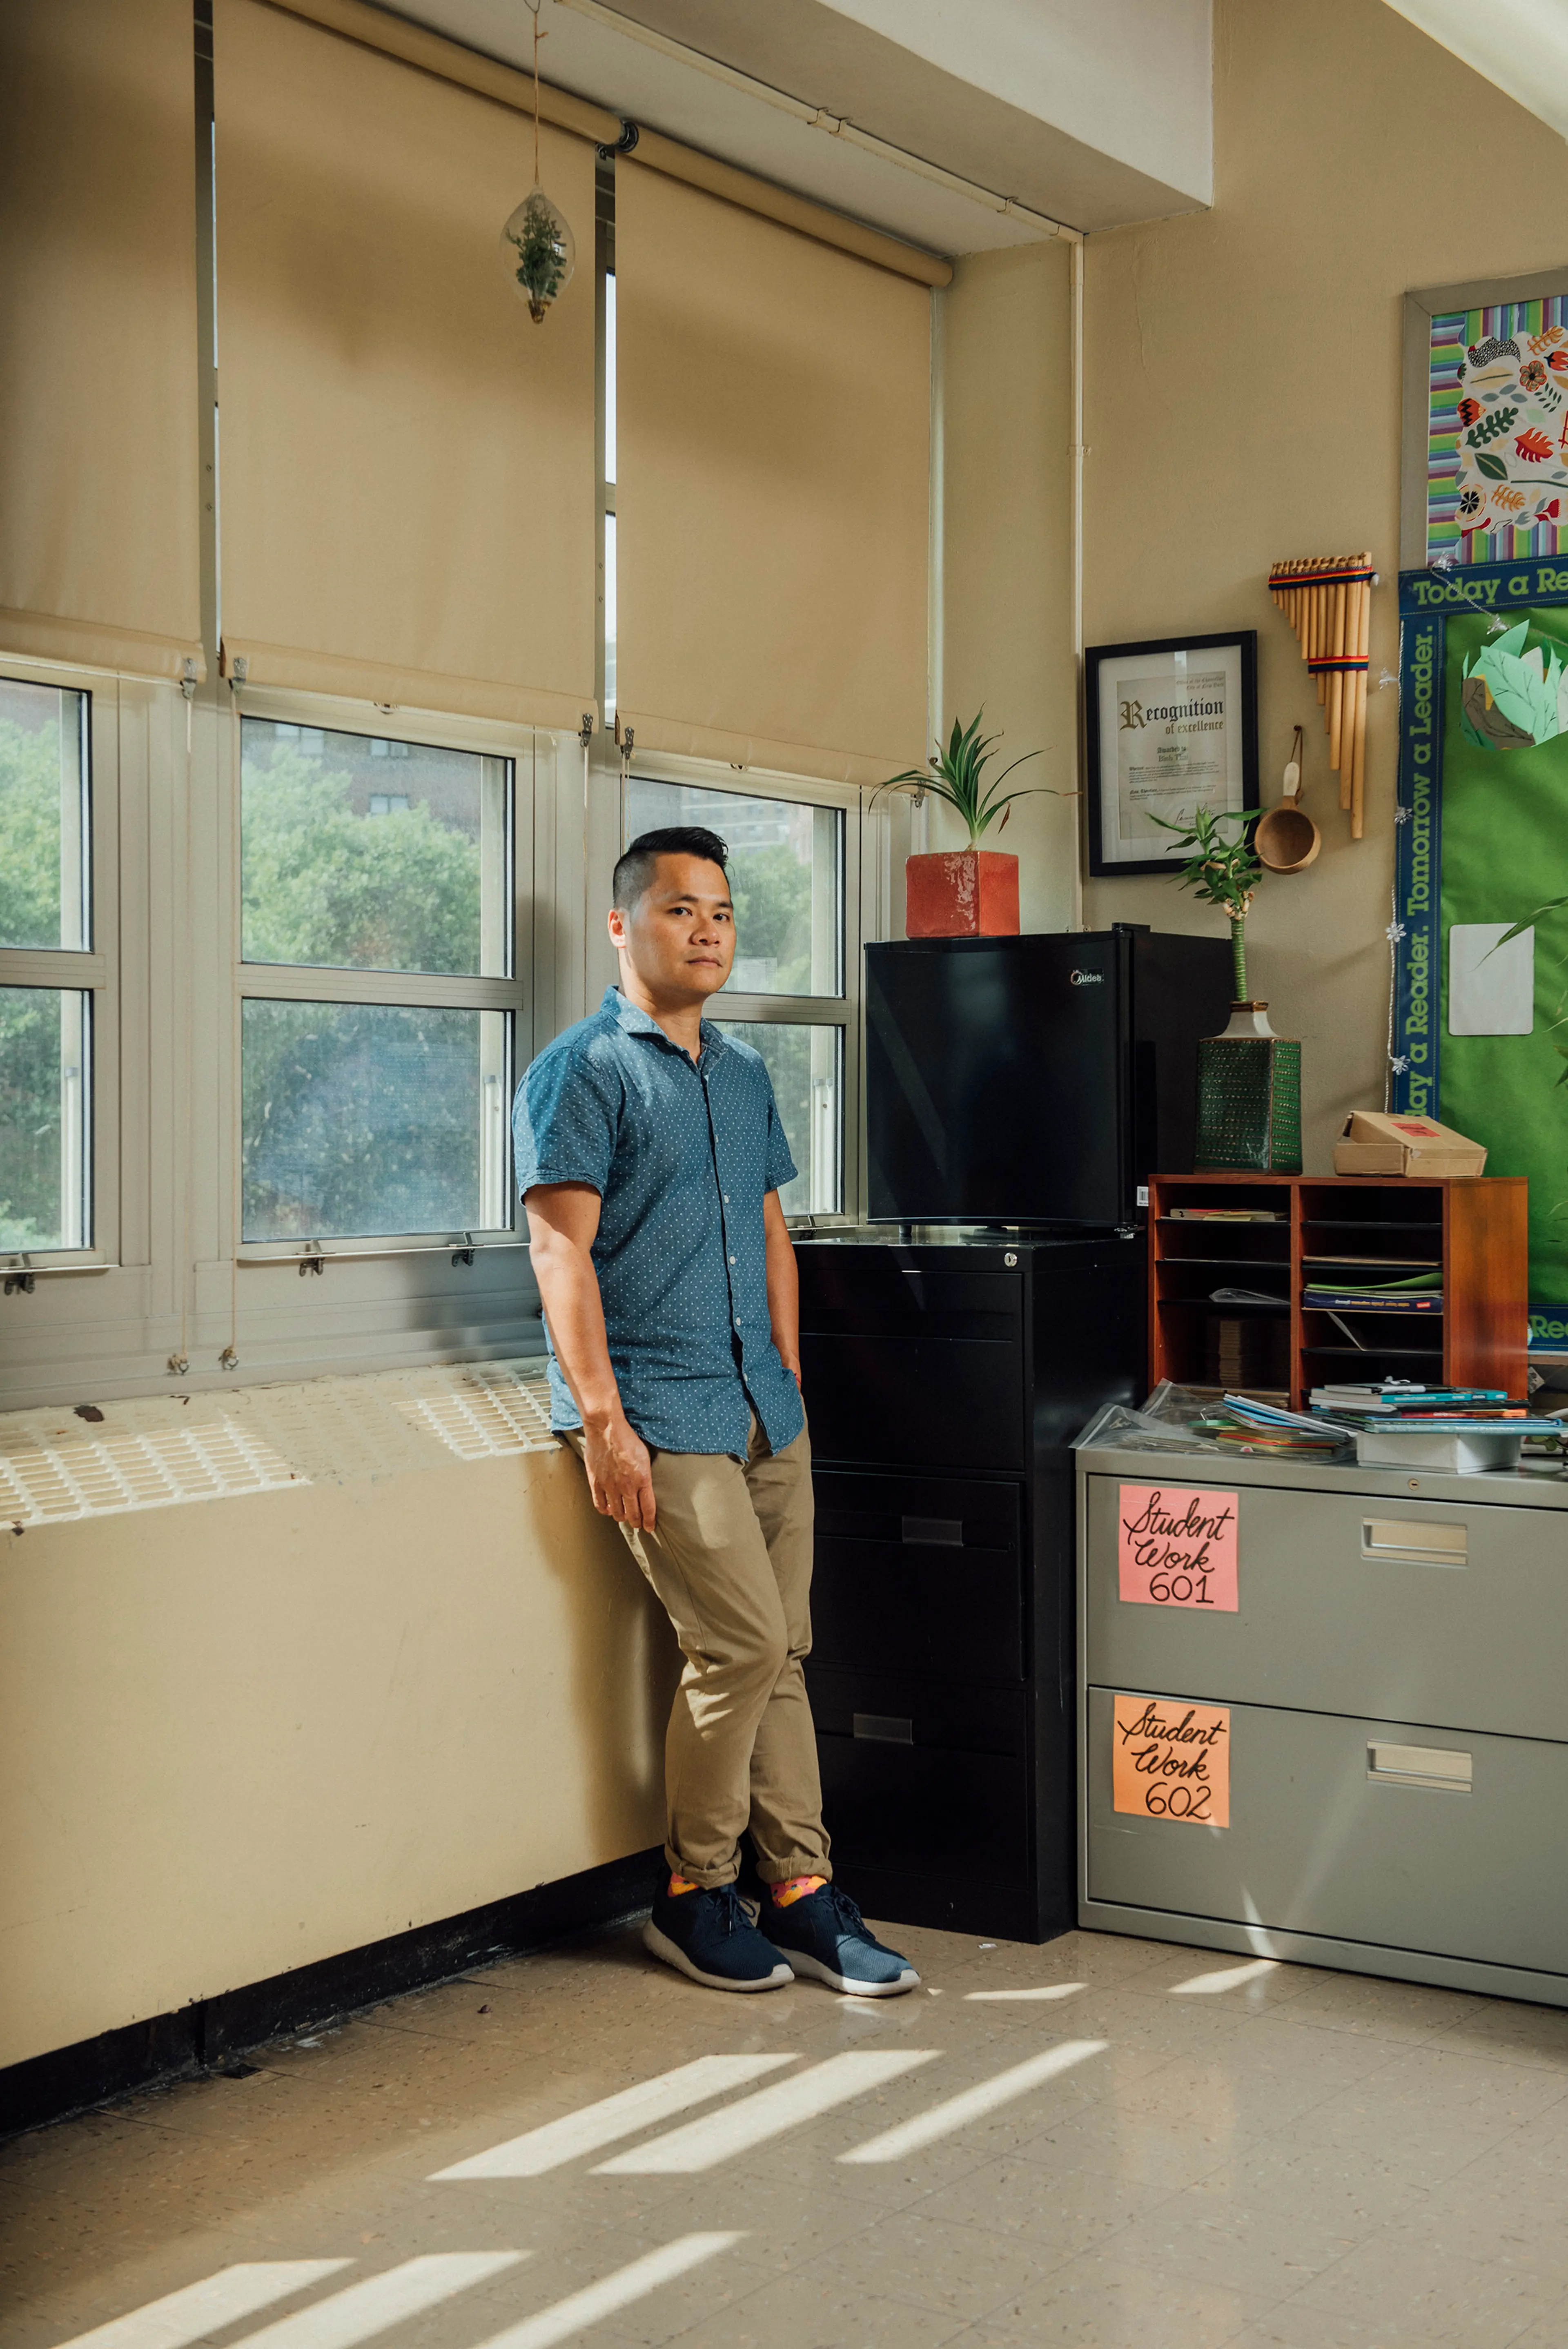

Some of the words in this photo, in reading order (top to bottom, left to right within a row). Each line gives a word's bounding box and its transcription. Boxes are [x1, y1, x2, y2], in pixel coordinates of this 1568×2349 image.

[1413, 577, 1501, 605] Today
[1508, 575, 1529, 596] a
[1409, 626, 1433, 736] Leader.
[1119, 697, 1224, 731] Recognition
[1165, 723, 1175, 734] of
[1178, 720, 1224, 733] excellence
[1413, 743, 1431, 765] a
[1406, 773, 1431, 917] Tomorrow
[1076, 973, 1102, 984] Midea
[1405, 925, 1429, 1035] Reader.
[1410, 1042, 1428, 1063] a
[1528, 1315, 1568, 1339] Re
[1123, 1491, 1235, 1545] Student
[1135, 1539, 1215, 1573] Work
[1149, 1572, 1214, 1603] 601
[1118, 1702, 1227, 1745] Student
[1131, 1743, 1210, 1781] Work
[1146, 1782, 1212, 1819] 602
